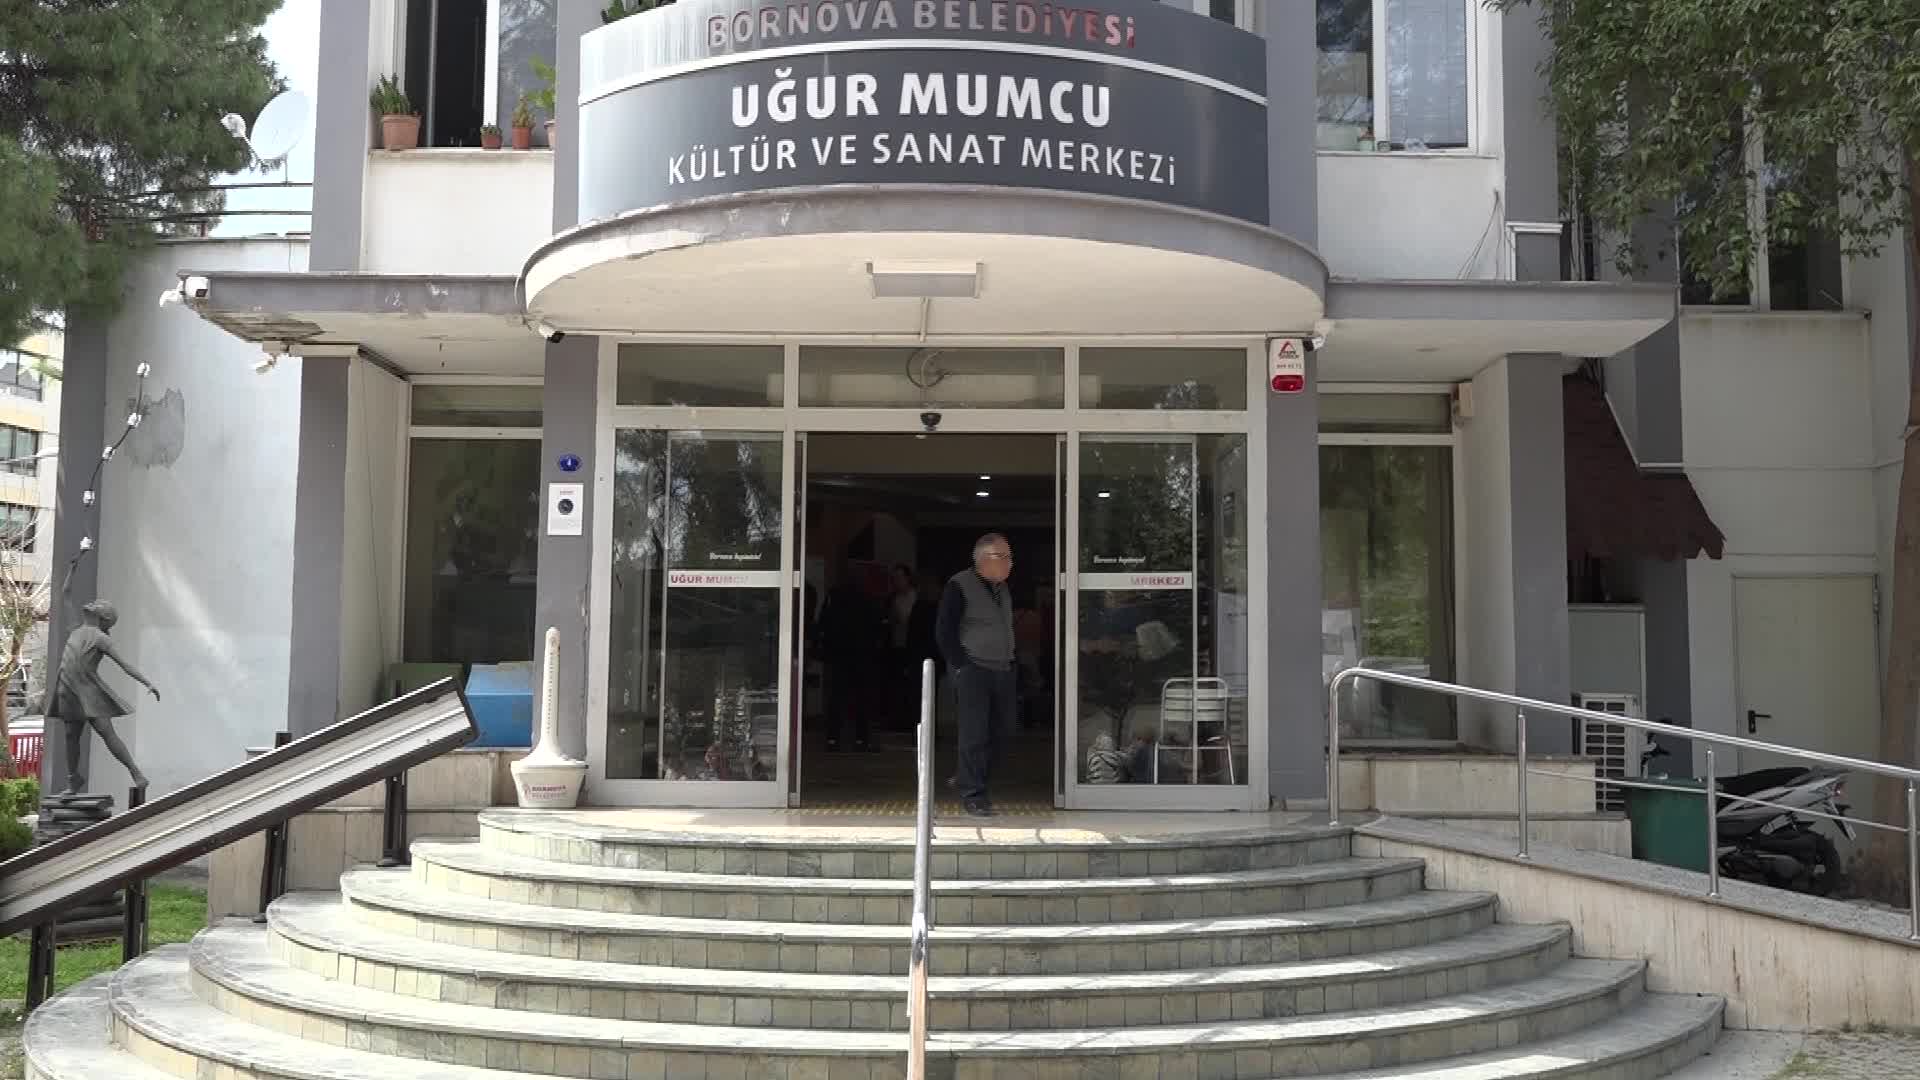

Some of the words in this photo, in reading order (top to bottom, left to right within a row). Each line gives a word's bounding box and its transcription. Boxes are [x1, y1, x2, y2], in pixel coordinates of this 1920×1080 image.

[707, 0, 898, 48] BORNOVA
[731, 66, 880, 128] UĞUR
[899, 72, 1110, 128] MUMCU
[668, 134, 797, 185] KÜLTÜR
[811, 134, 857, 166] VE
[872, 132, 1006, 166] SANAT
